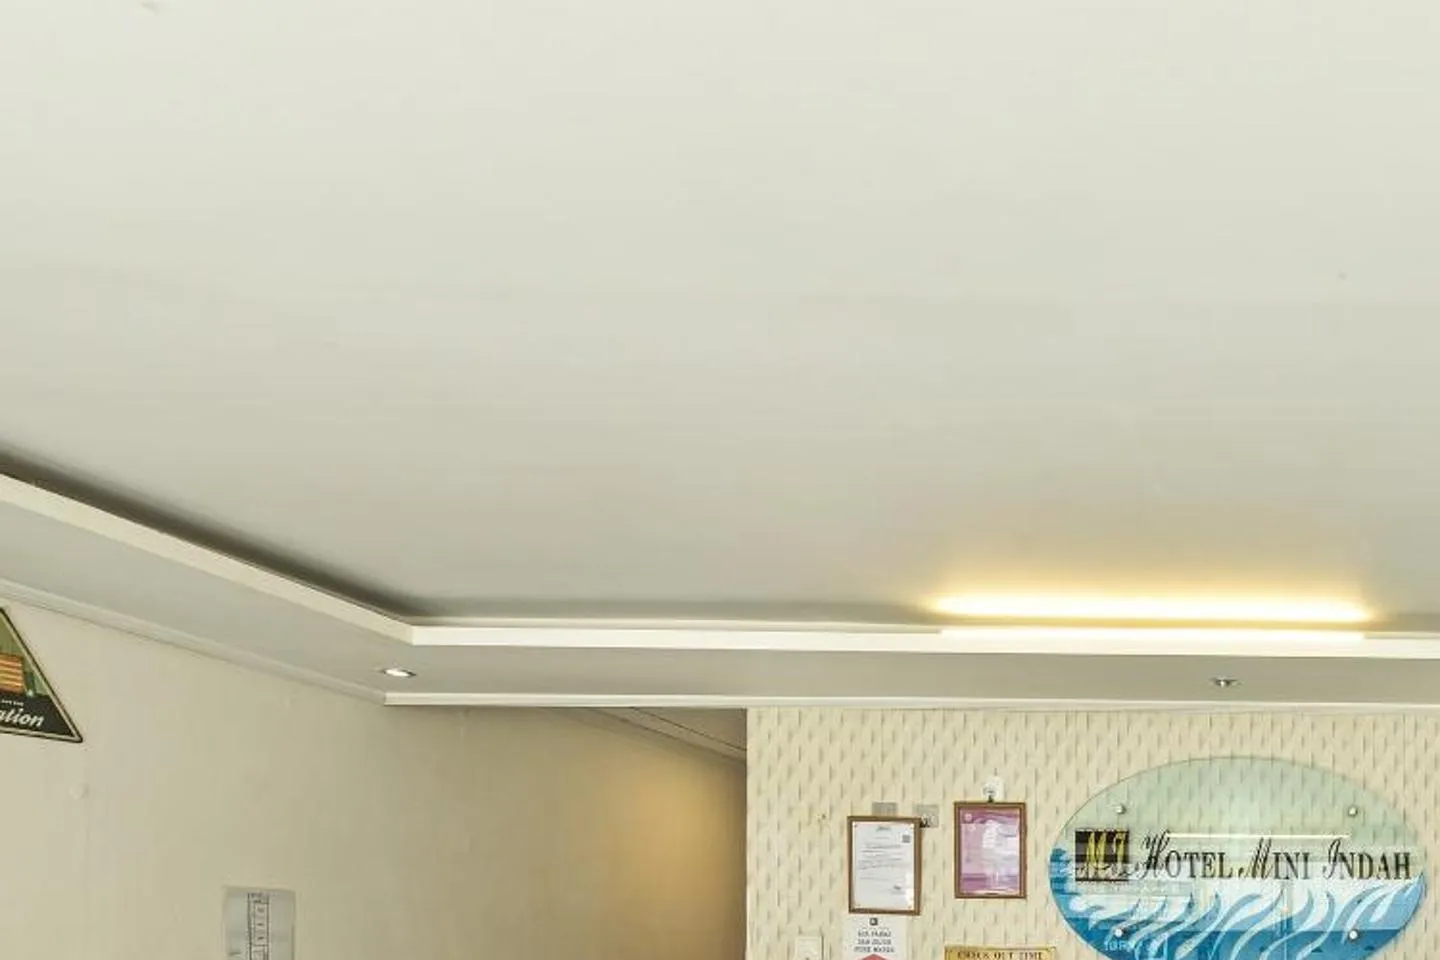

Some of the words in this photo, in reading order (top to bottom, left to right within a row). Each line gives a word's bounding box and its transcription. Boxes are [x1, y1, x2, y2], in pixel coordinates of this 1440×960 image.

[1138, 829, 1232, 880] HOTEL
[1238, 837, 1310, 880] MINI
[1322, 837, 1411, 880] INDAH
